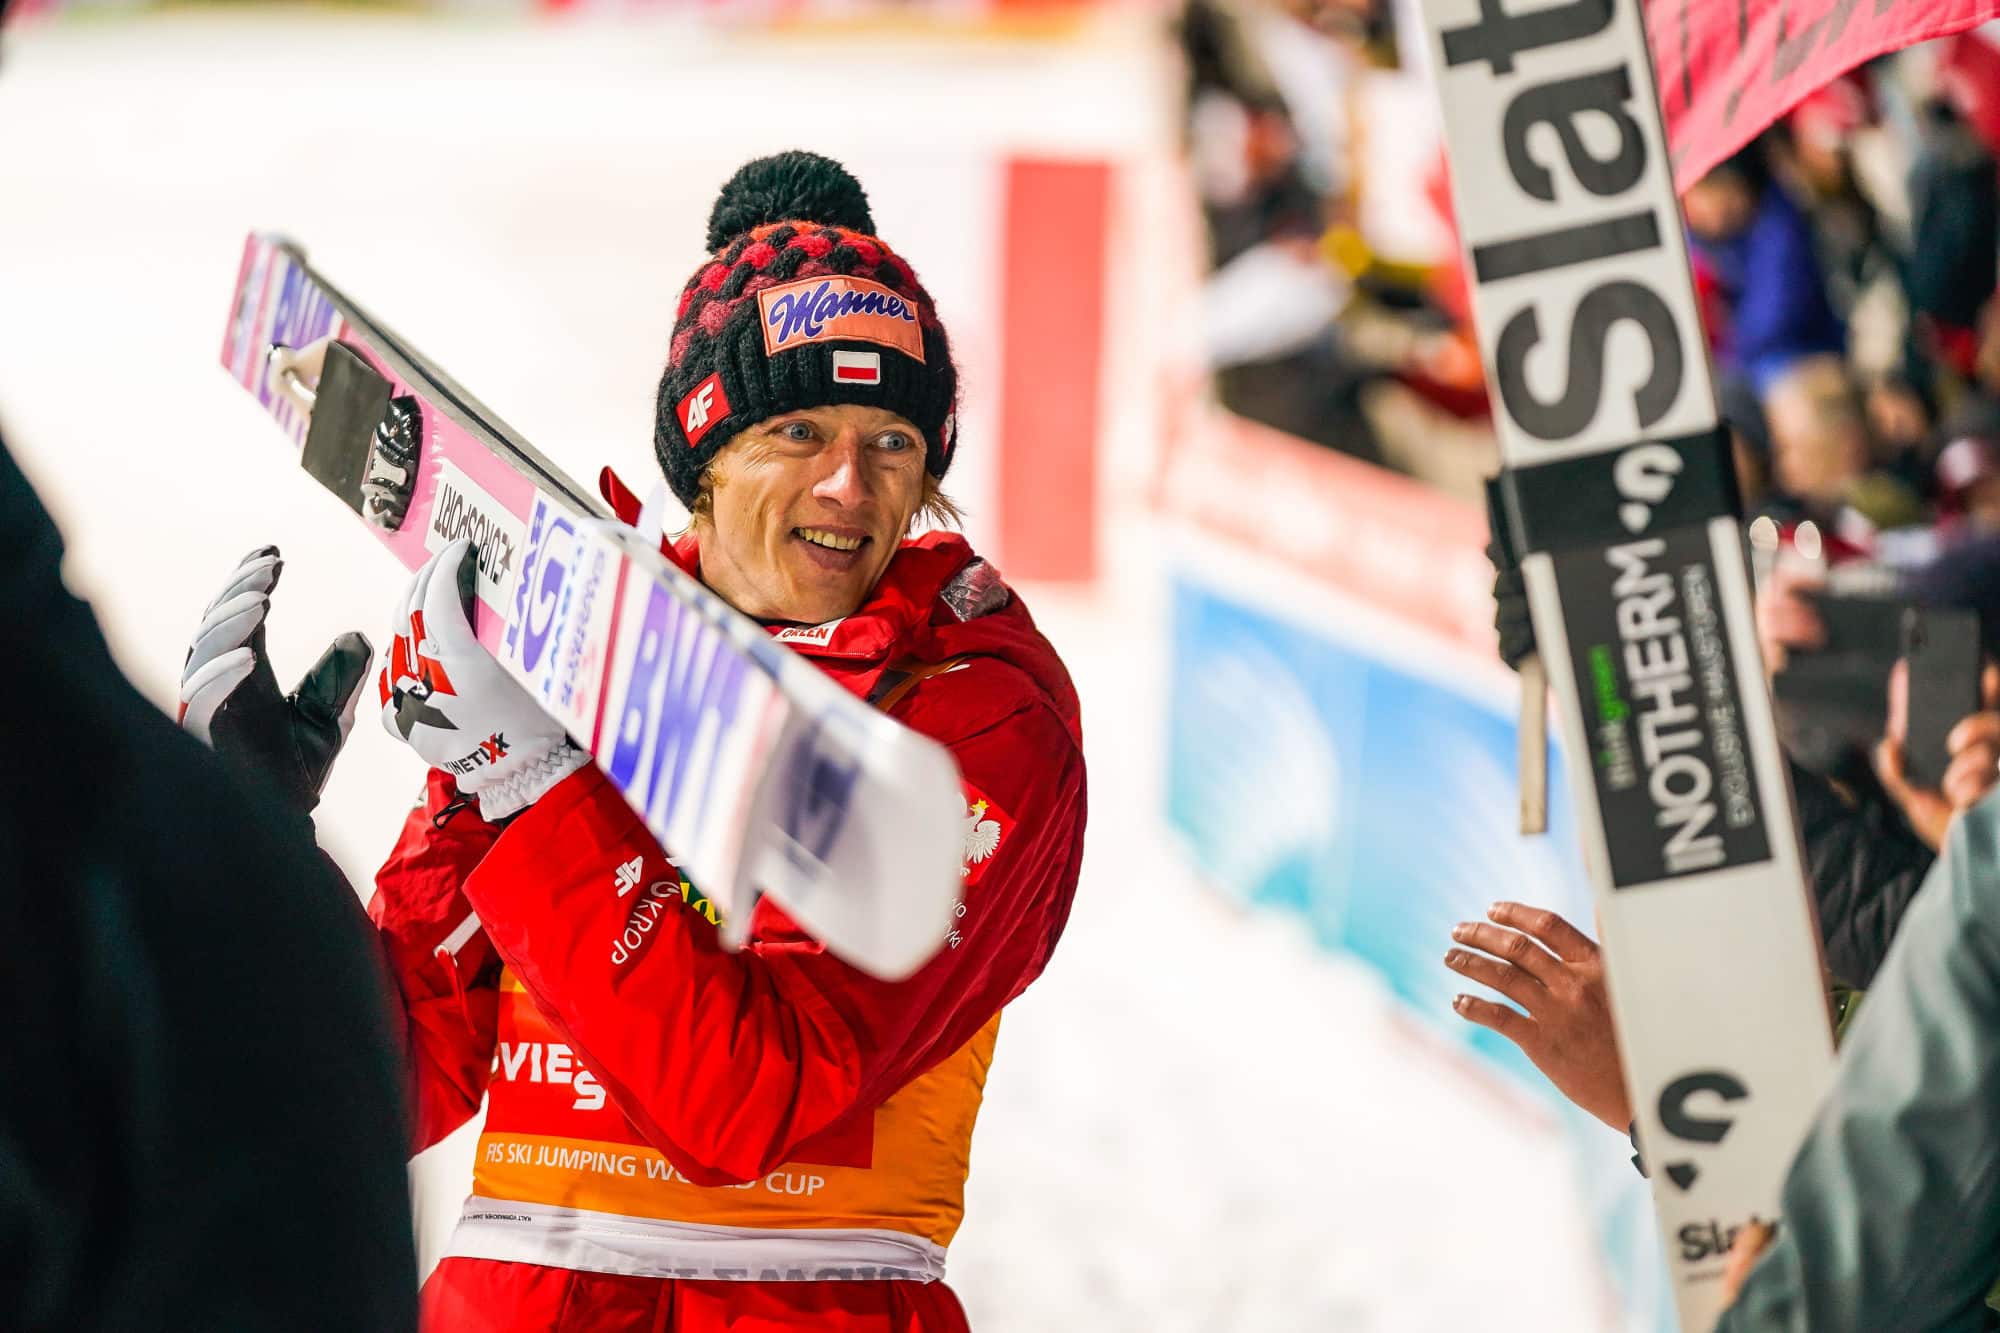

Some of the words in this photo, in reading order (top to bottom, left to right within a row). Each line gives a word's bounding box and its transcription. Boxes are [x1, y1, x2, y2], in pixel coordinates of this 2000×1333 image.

[768, 281, 915, 343] Manner
[687, 382, 715, 433] 4F
[782, 627, 828, 640] ORLEN
[1606, 538, 1727, 873] INOTHERM
[614, 855, 644, 898] 4F
[486, 1142, 504, 1164] FIS
[507, 1143, 532, 1165] SKI
[536, 1145, 637, 1178] JUMPING
[765, 1171, 826, 1197] CUP
